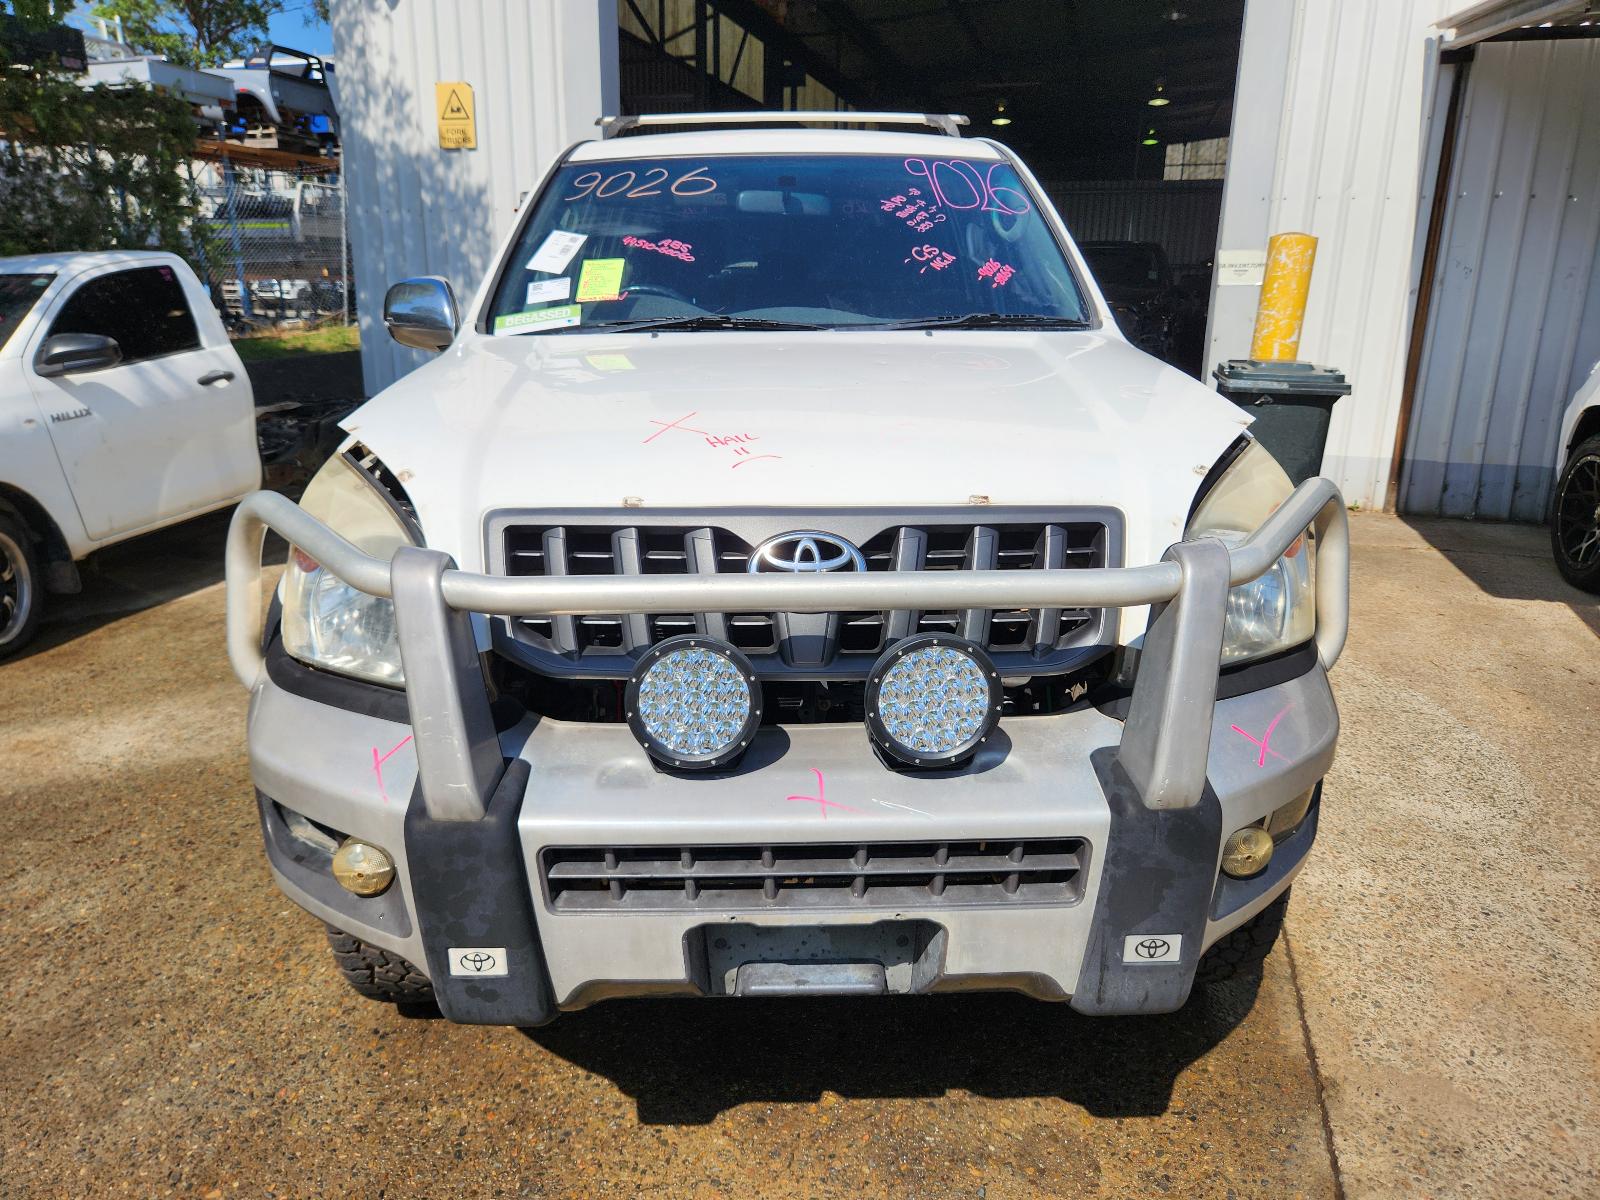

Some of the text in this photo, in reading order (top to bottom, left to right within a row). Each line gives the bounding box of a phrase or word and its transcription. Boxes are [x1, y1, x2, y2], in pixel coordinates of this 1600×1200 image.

[445, 128, 466, 136] FORK
[441, 136, 472, 145] TRUCKS
[563, 167, 718, 201] 9026
[904, 158, 1031, 215] 9026
[657, 239, 692, 253] ABS
[503, 308, 572, 327] DEGASSED
[50, 408, 93, 424] HILUX
